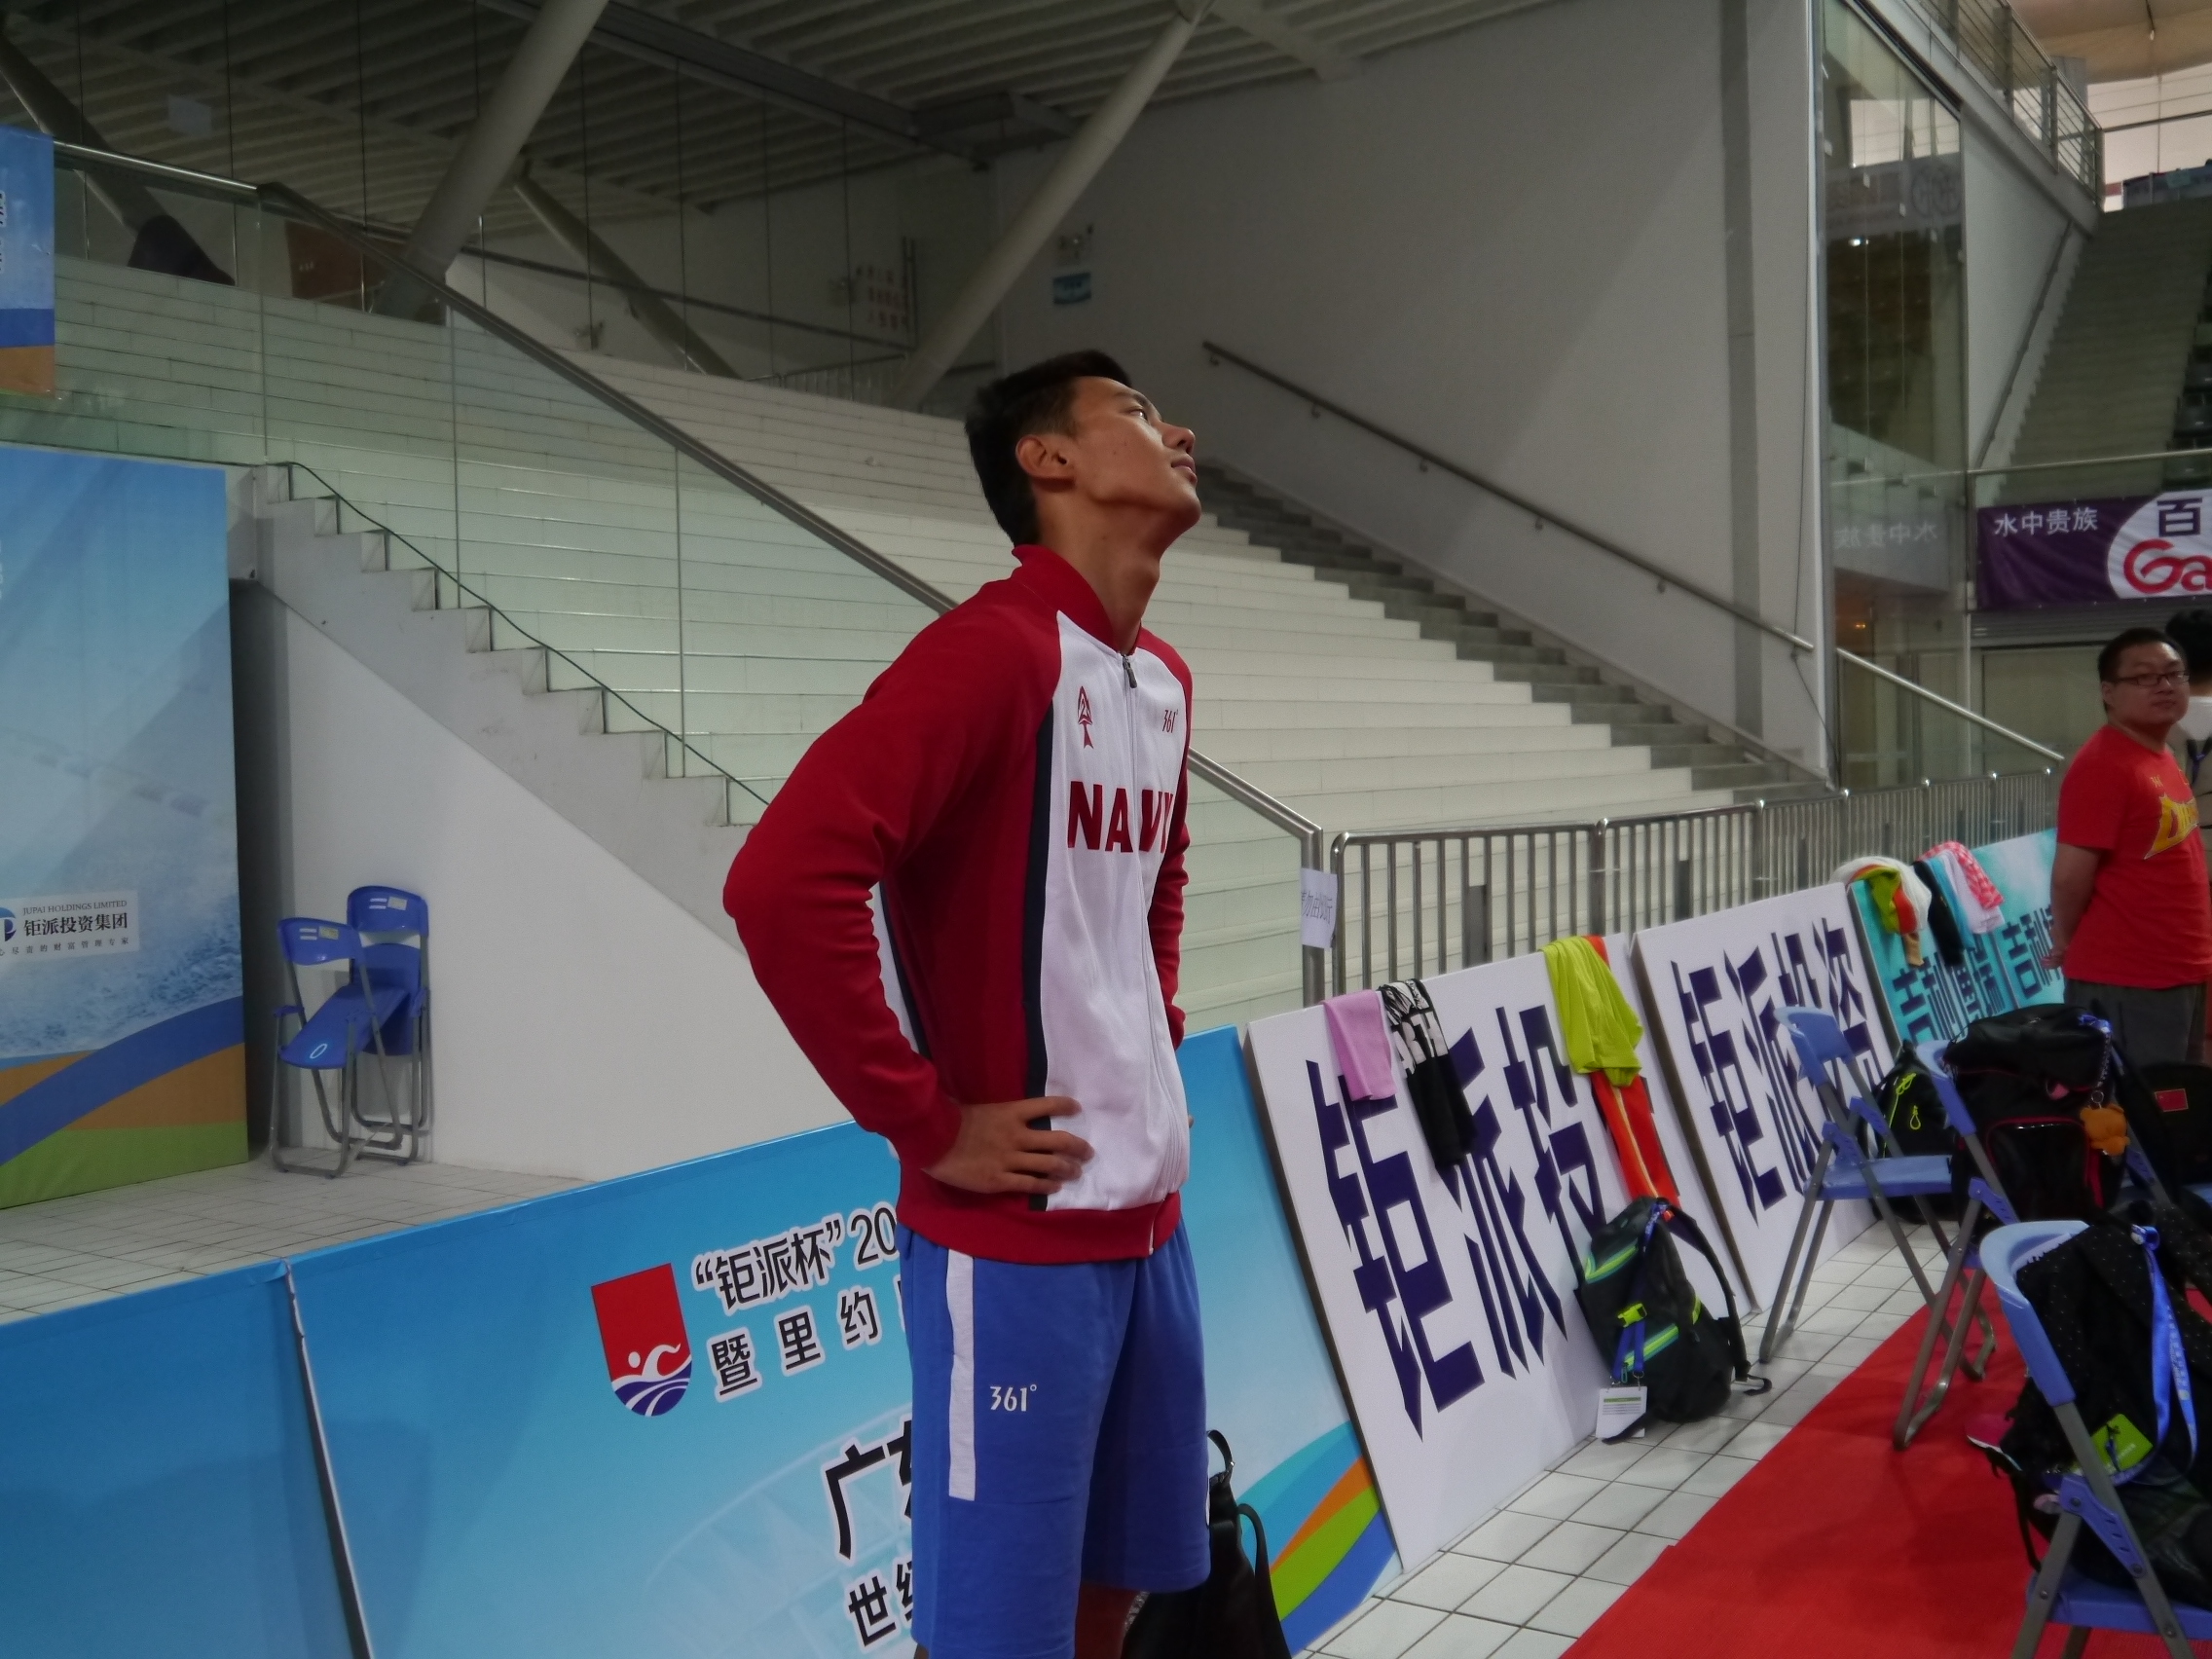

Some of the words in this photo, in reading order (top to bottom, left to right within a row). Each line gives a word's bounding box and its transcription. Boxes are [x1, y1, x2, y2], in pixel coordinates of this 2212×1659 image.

[1993, 506, 2099, 537] 水中贵族
[2157, 498, 2203, 538] 百
[22, 904, 47, 916] JUPAI
[48, 902, 92, 913] HOLDINGS
[93, 900, 128, 909] LIMITED
[23, 912, 129, 937] 钜派投资集团
[1306, 1006, 1681, 1444] 钜派投
[711, 1281, 904, 1396] 暨里约
